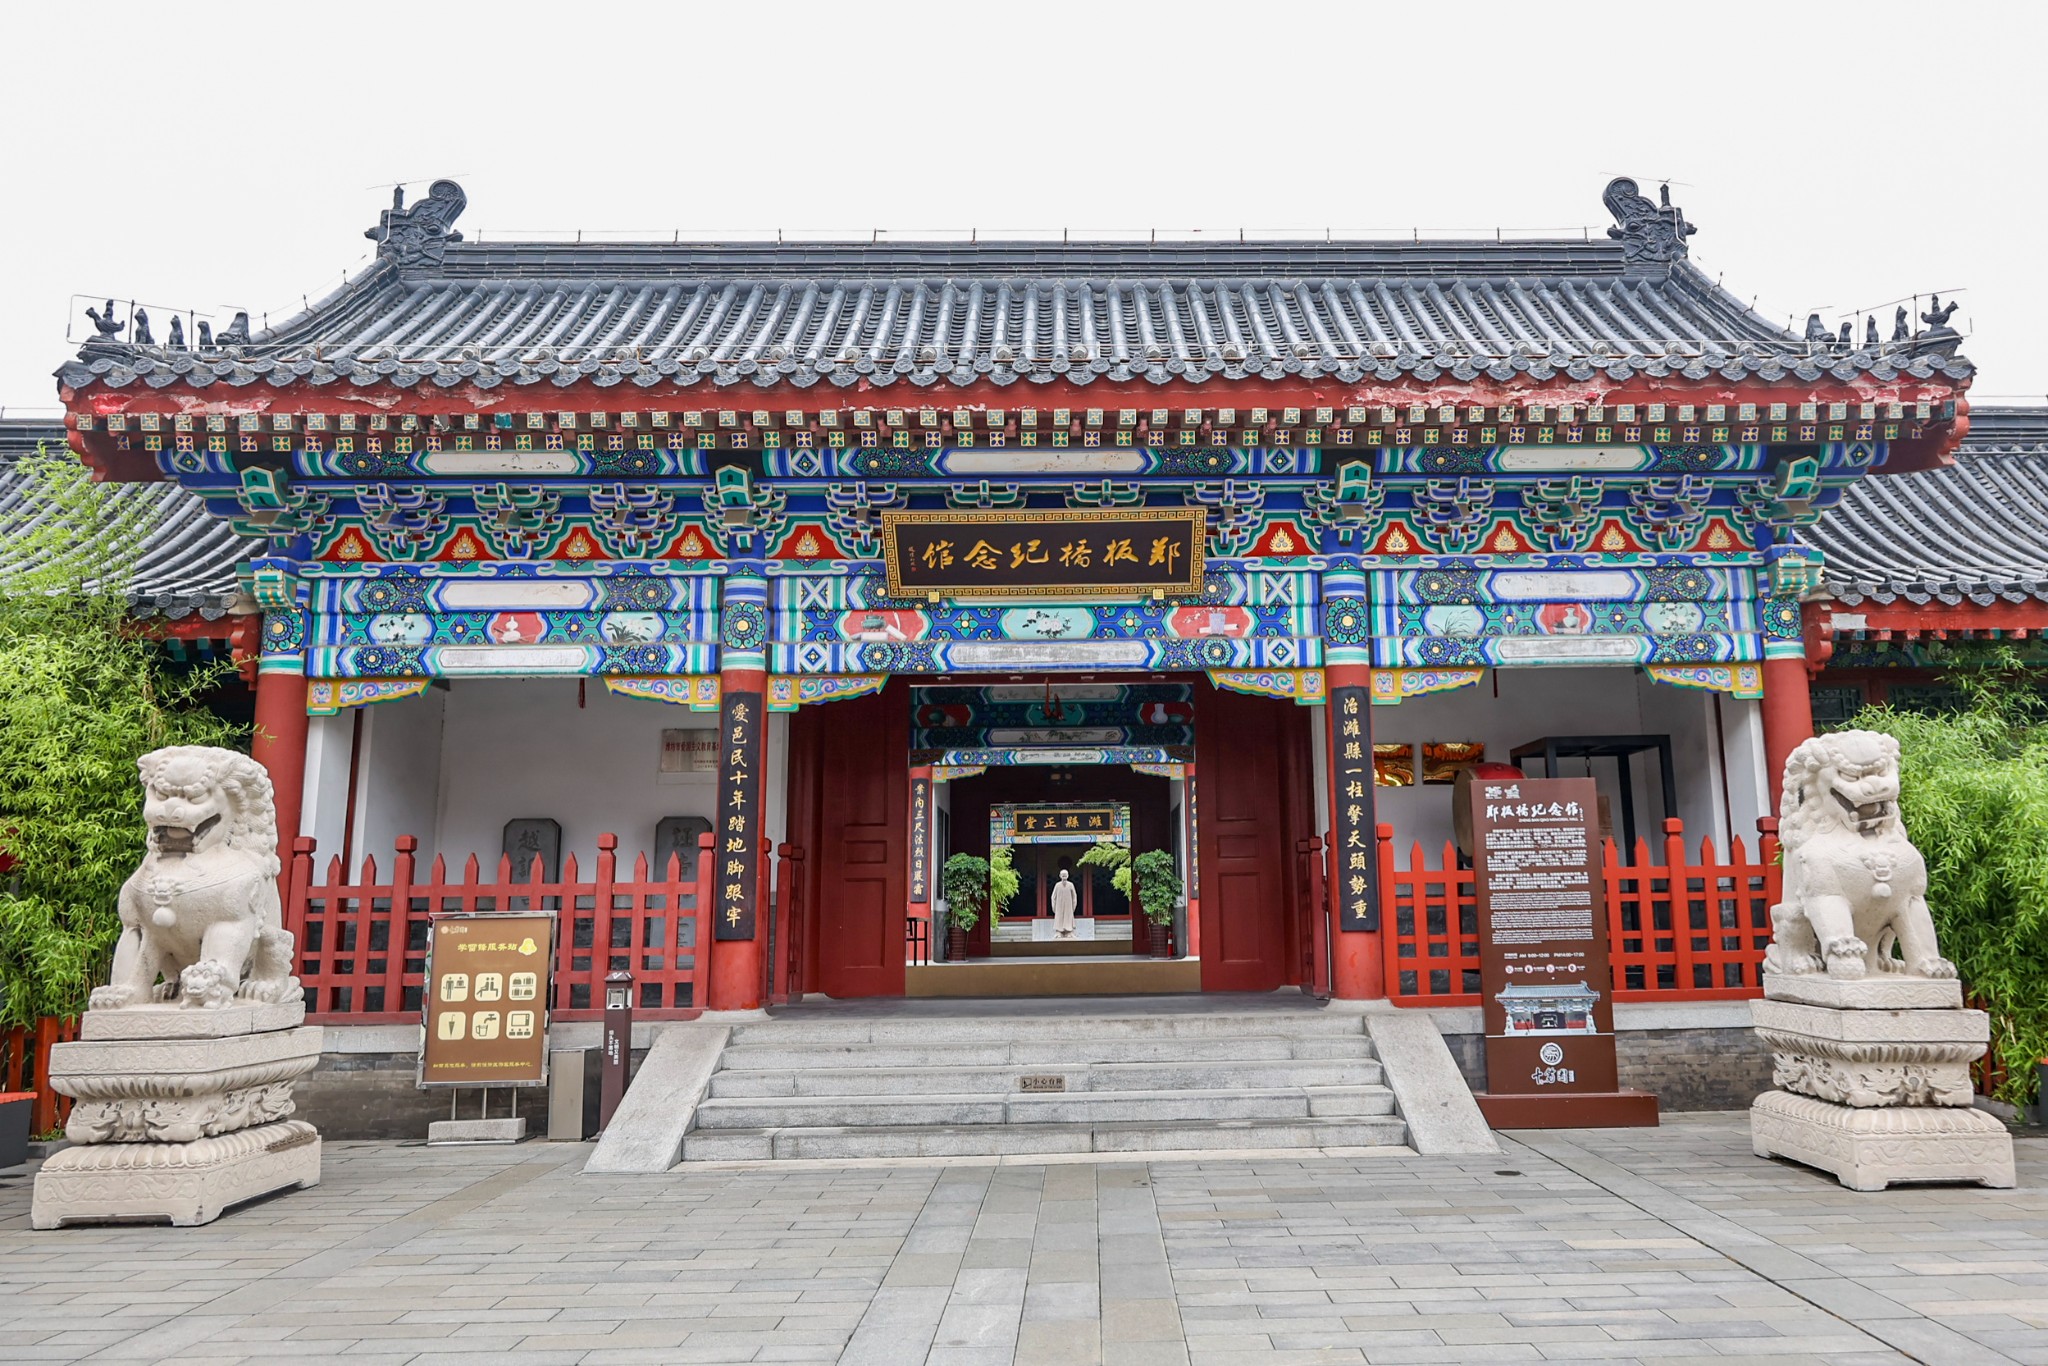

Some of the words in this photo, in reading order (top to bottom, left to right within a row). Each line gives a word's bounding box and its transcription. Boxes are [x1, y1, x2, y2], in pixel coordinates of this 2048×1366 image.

[457, 942, 518, 952] 学雷锋服务站
